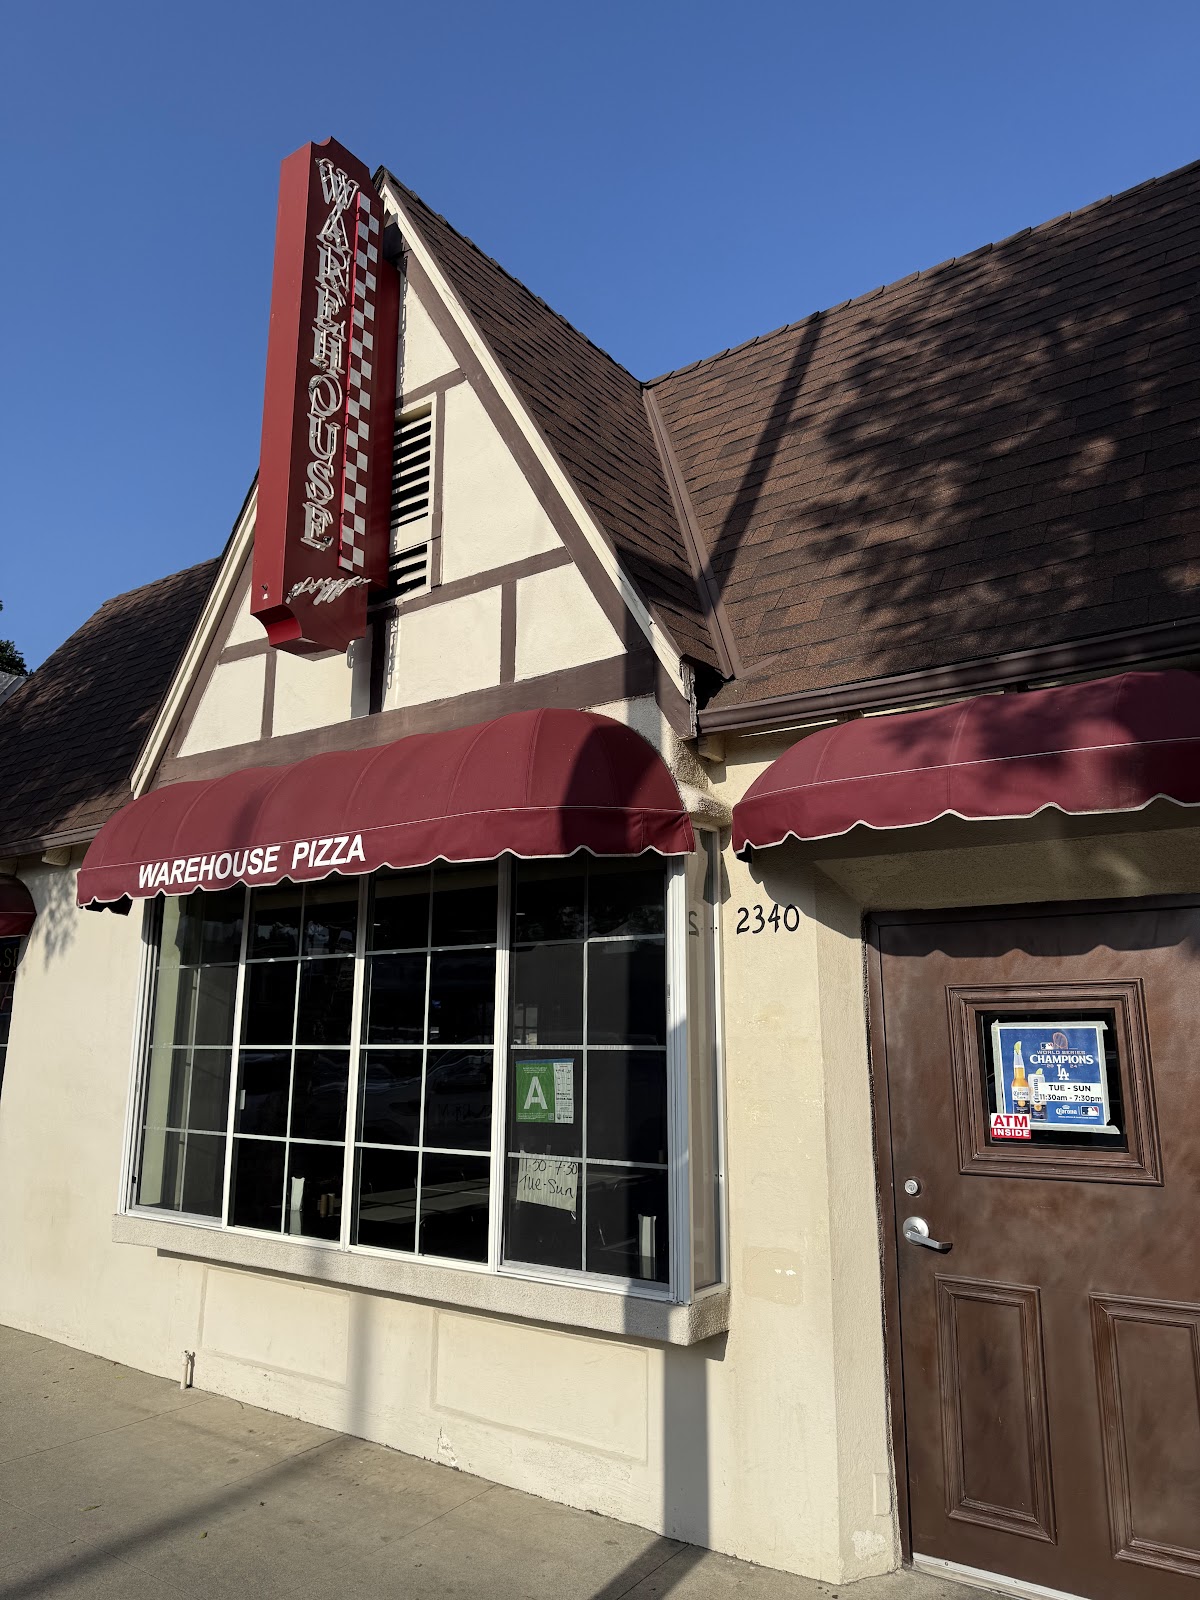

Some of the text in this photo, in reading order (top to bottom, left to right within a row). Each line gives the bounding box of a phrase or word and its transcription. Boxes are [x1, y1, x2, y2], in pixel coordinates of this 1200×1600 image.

[301, 157, 359, 551] WAREHOUSE
[138, 834, 366, 888] WAREHOUSE PIZZA
[736, 903, 800, 935] 2340
[1029, 1054, 1094, 1065] CHAMPIONS
[1056, 1064, 1070, 1080] LA
[523, 1076, 549, 1110] A
[1074, 1095, 1103, 1103] 7:30pm
[1056, 1107, 1077, 1115] Corona
[993, 1115, 1029, 1128] ATM
[993, 1128, 1030, 1137] INSIDE
[555, 1162, 578, 1176] 7:30
